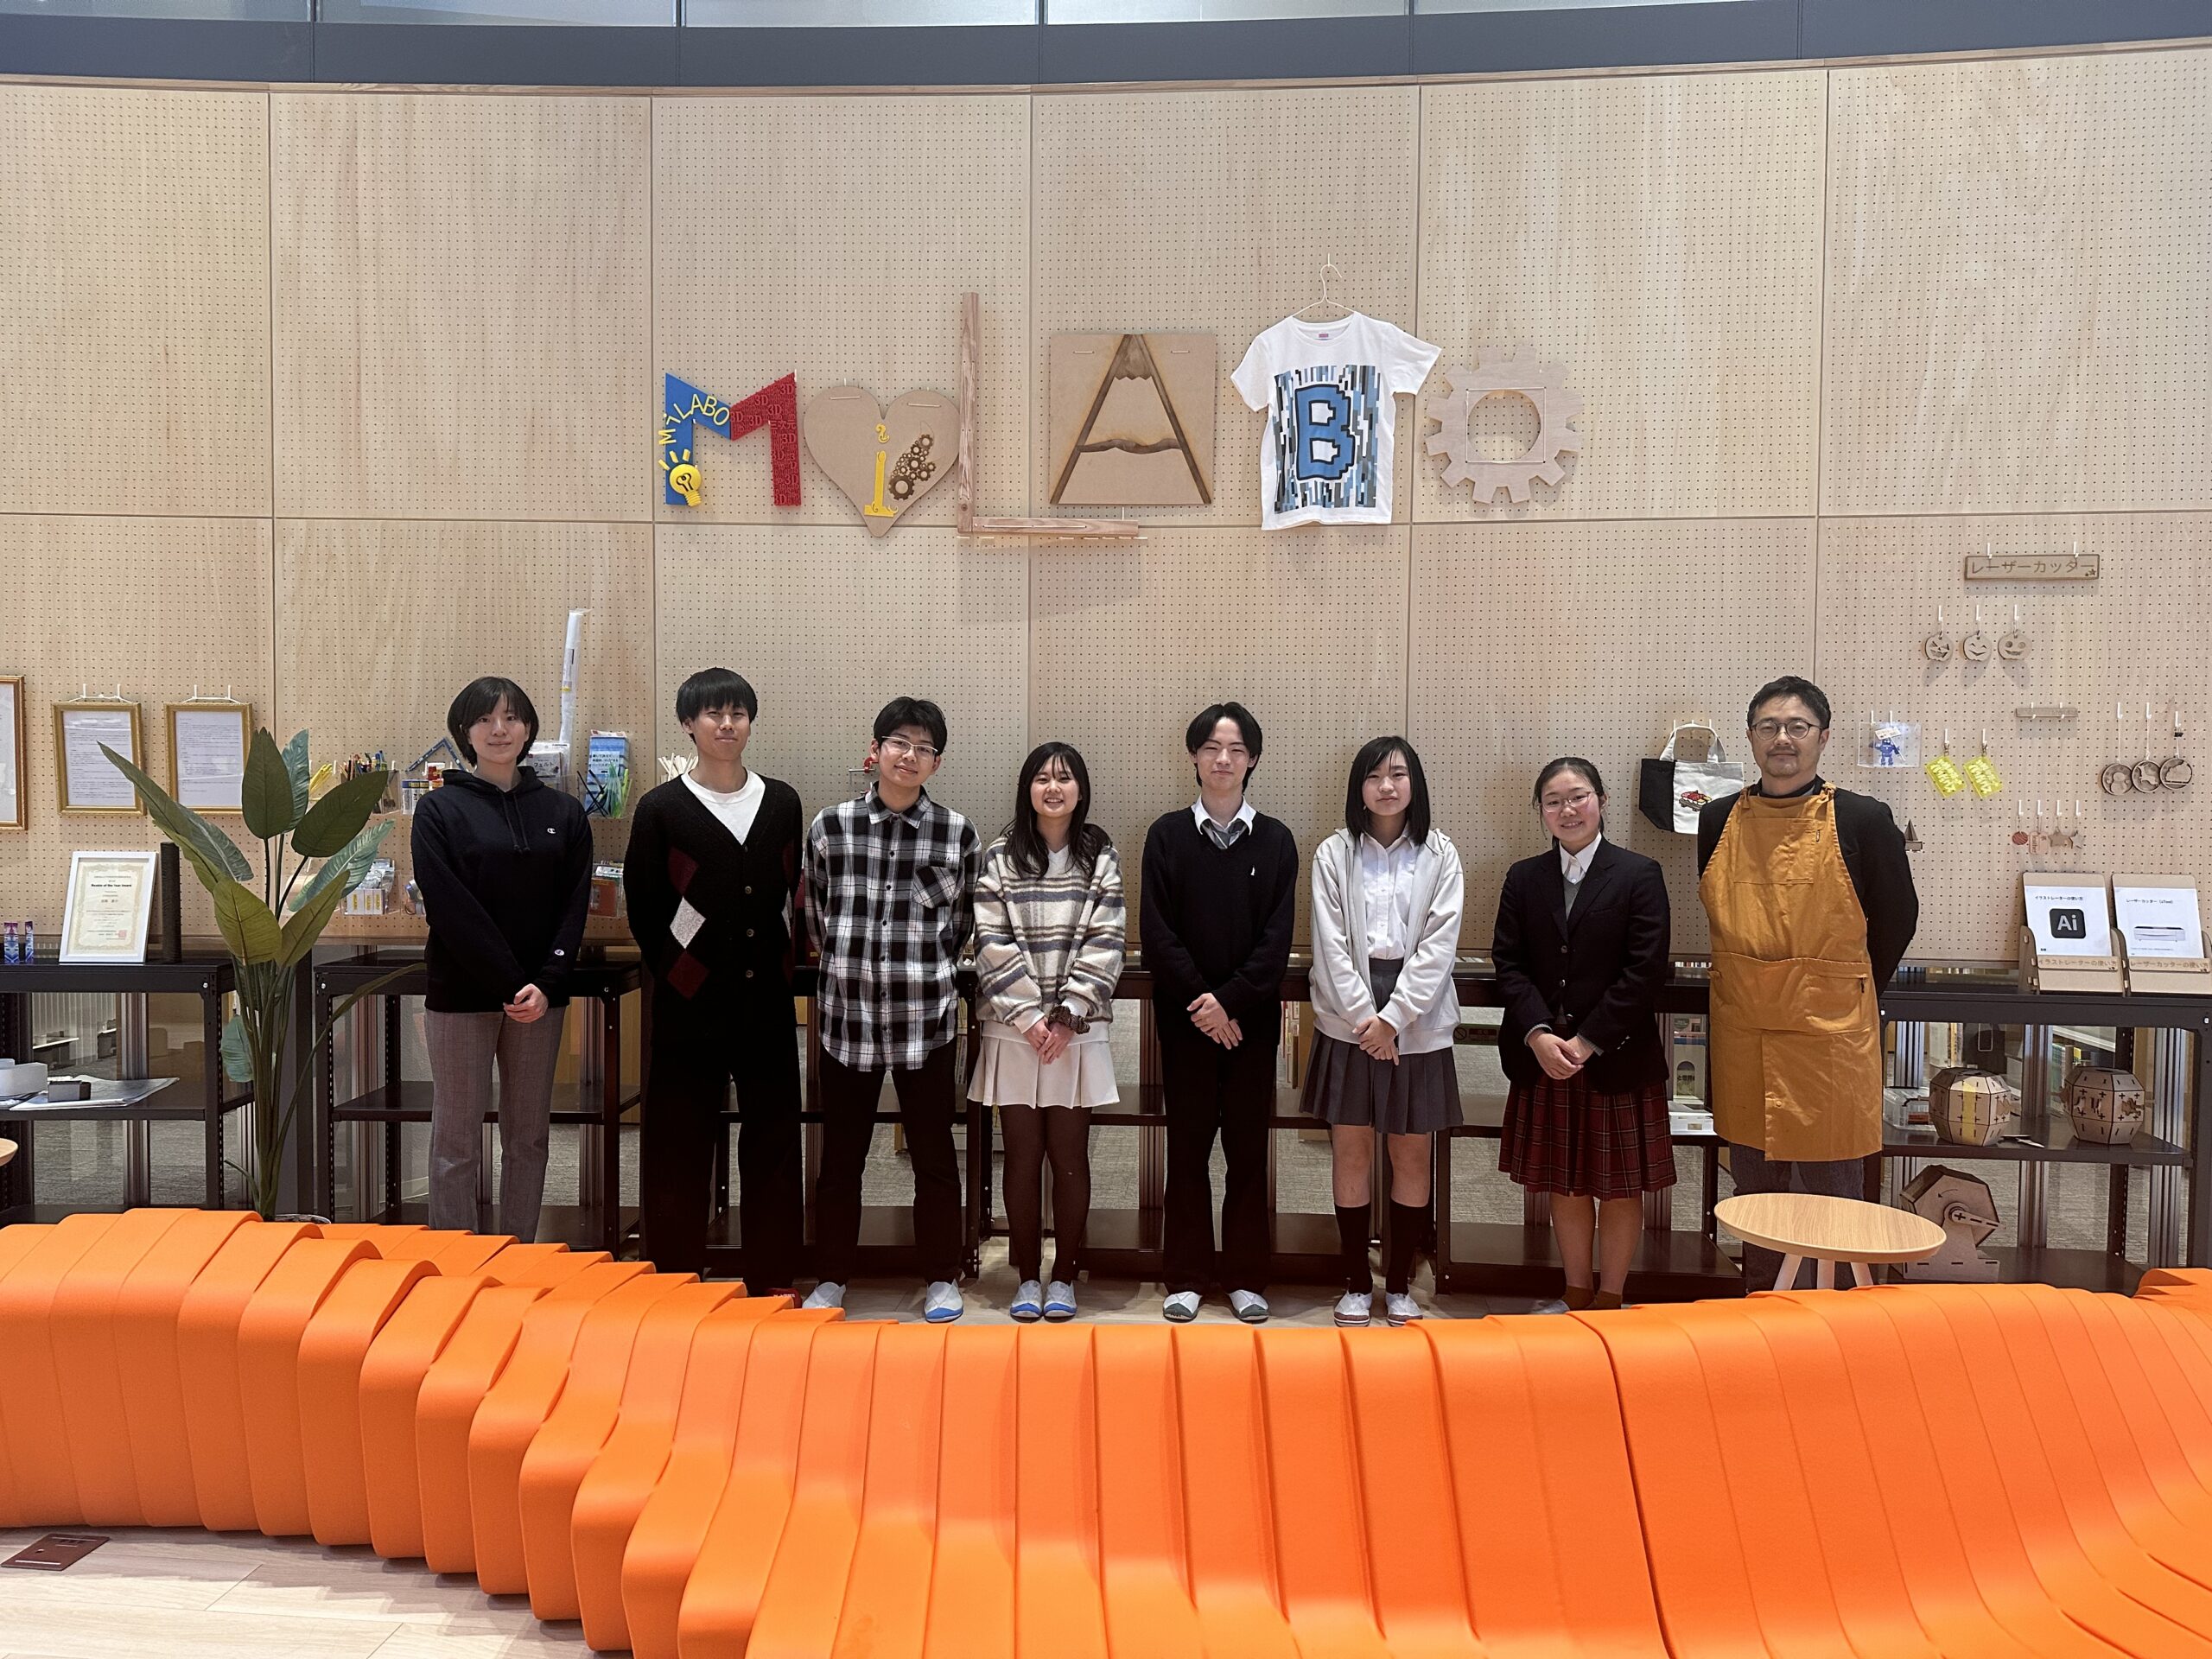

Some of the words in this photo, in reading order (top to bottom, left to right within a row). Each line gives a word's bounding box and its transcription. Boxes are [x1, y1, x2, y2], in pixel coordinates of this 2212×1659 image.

[780, 384, 794, 395] 3D
[754, 395, 769, 406] 3D
[768, 404, 782, 415] 3D
[658, 393, 730, 445] MiLABO
[749, 415, 762, 426] 3D
[782, 433, 797, 444] 3D
[785, 474, 798, 486] 3D
[1972, 560, 2094, 574] レーザーカッター
[2057, 914, 2078, 931] Ai
